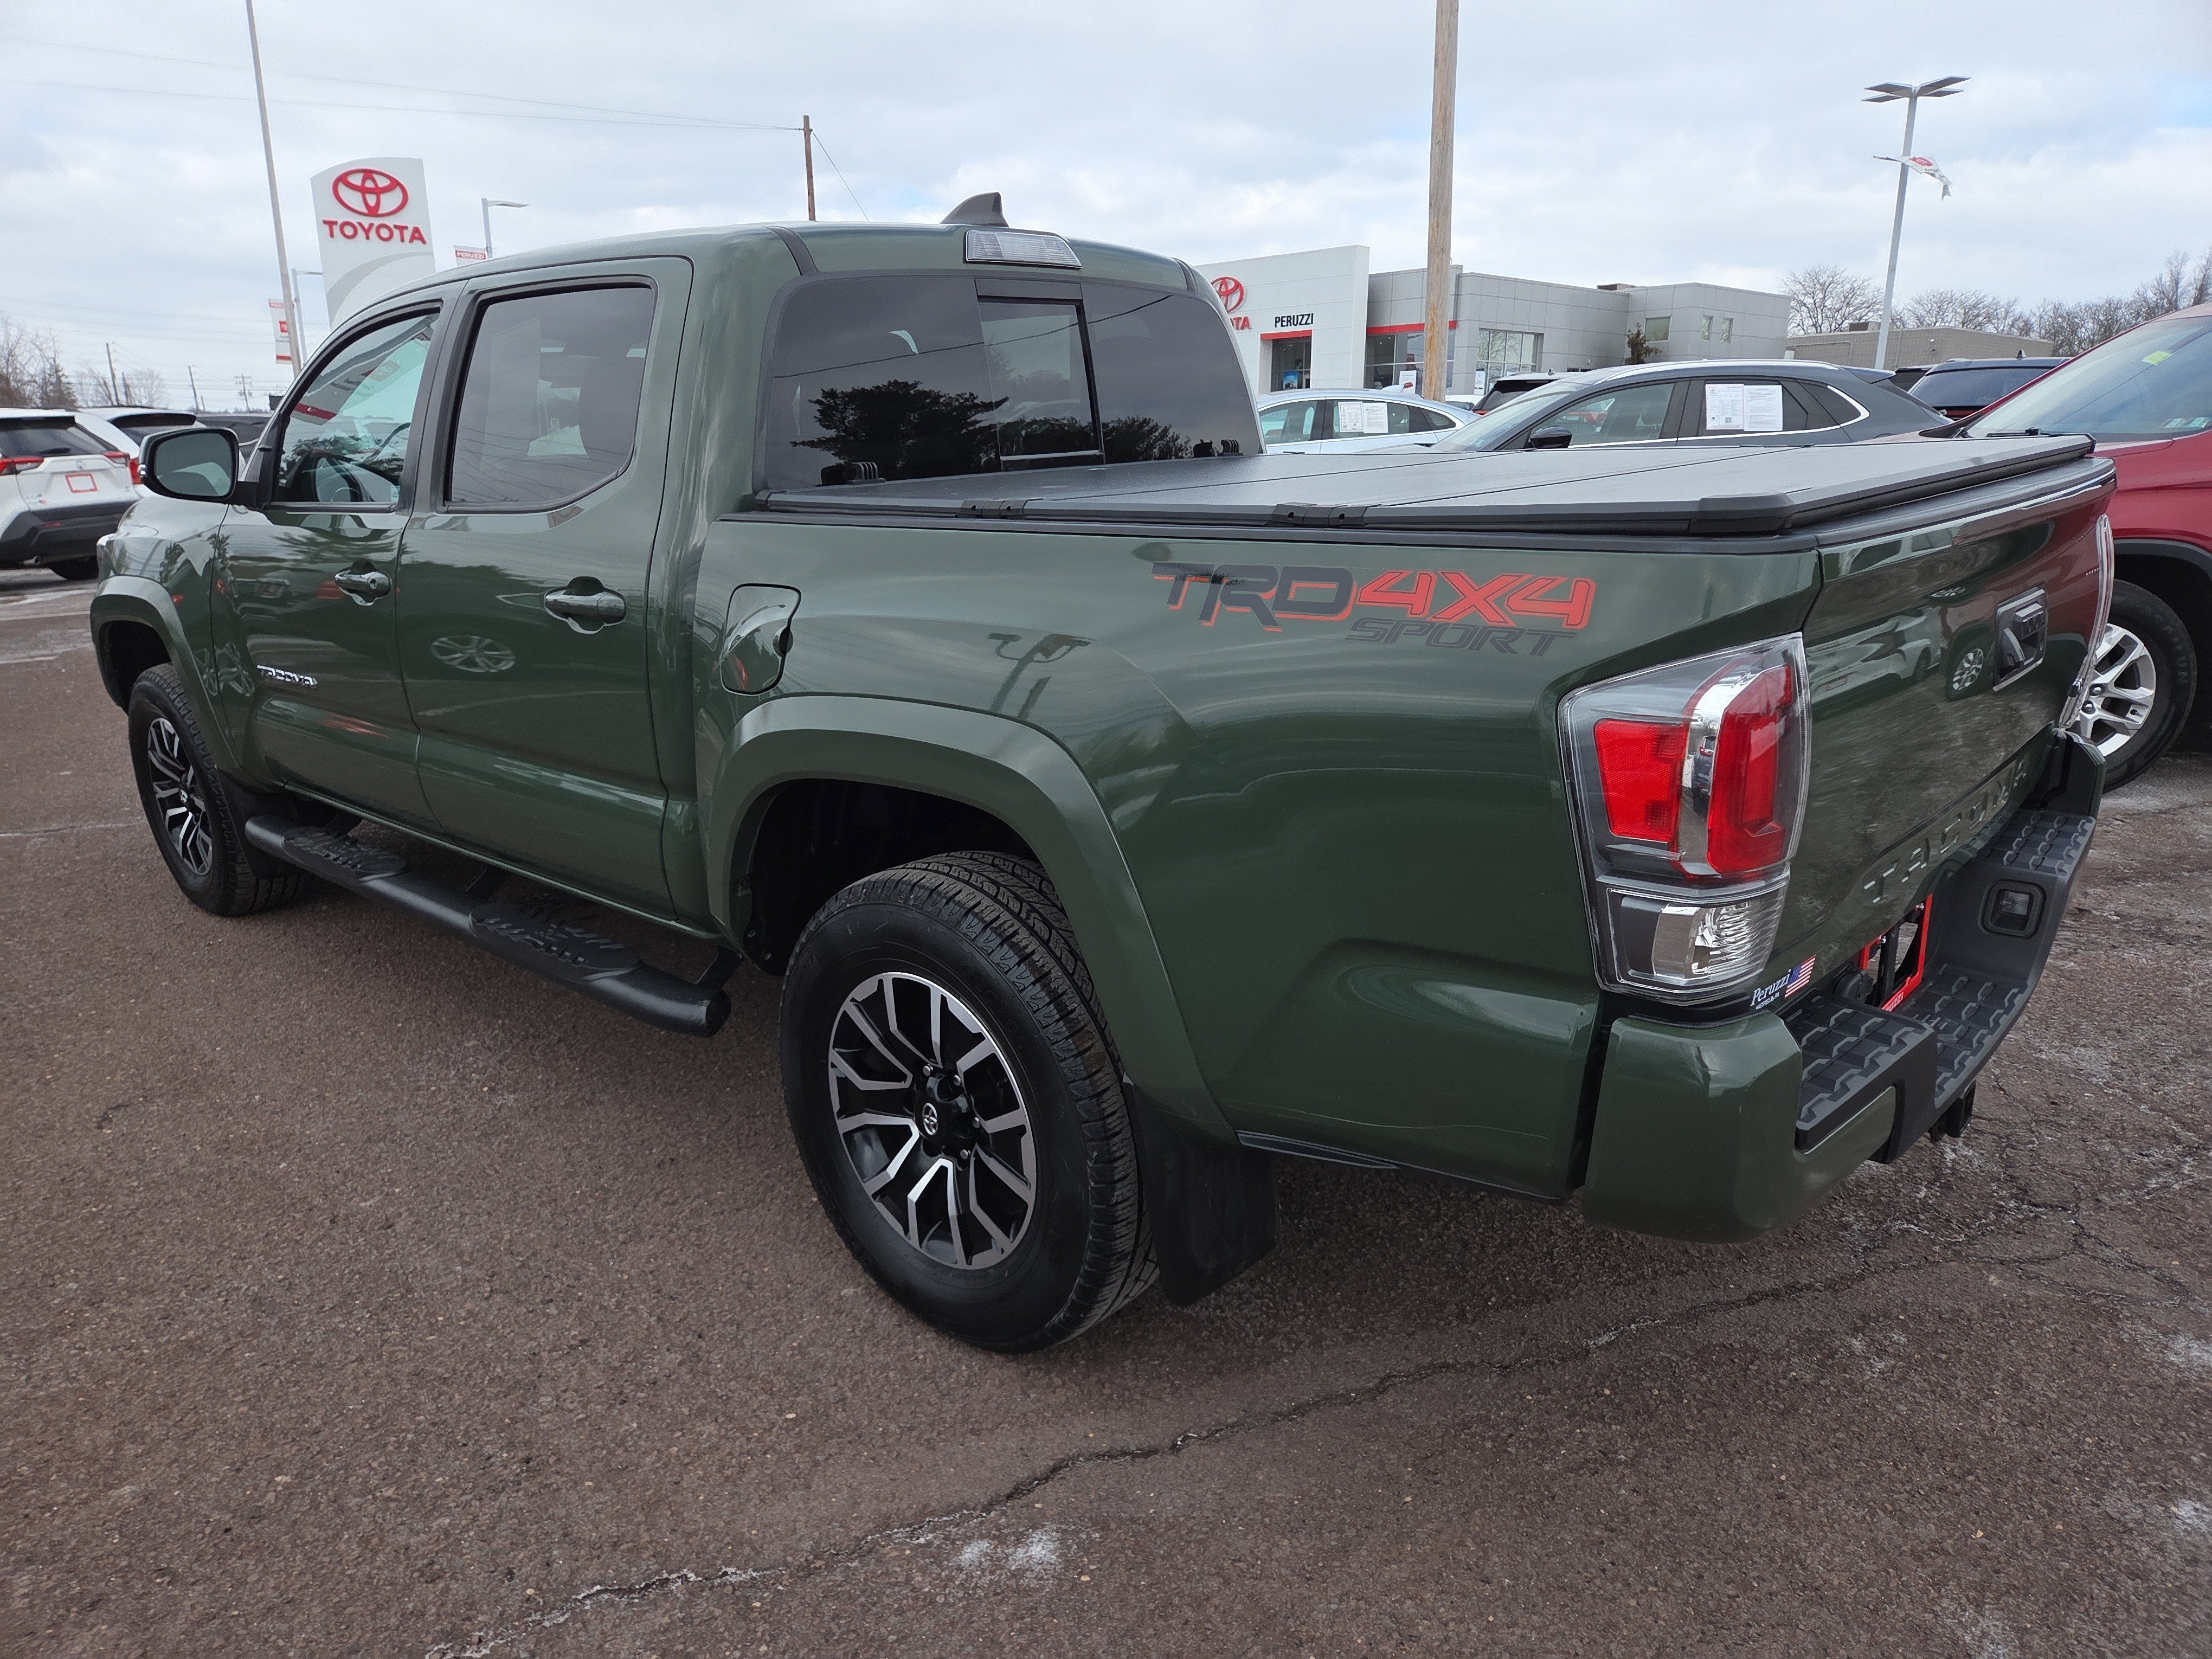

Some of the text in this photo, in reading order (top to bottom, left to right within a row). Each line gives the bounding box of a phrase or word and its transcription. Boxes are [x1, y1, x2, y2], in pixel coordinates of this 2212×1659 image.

[323, 220, 427, 244] TOYOTA
[1275, 313, 1314, 328] PERUZZI
[1151, 562, 1596, 632] TRD 4X4
[1345, 617, 1577, 658] SPORT
[257, 665, 318, 689] TACOMA
[1863, 760, 2027, 904] TACOMA
[1750, 968, 1791, 1007] Peruzzi
